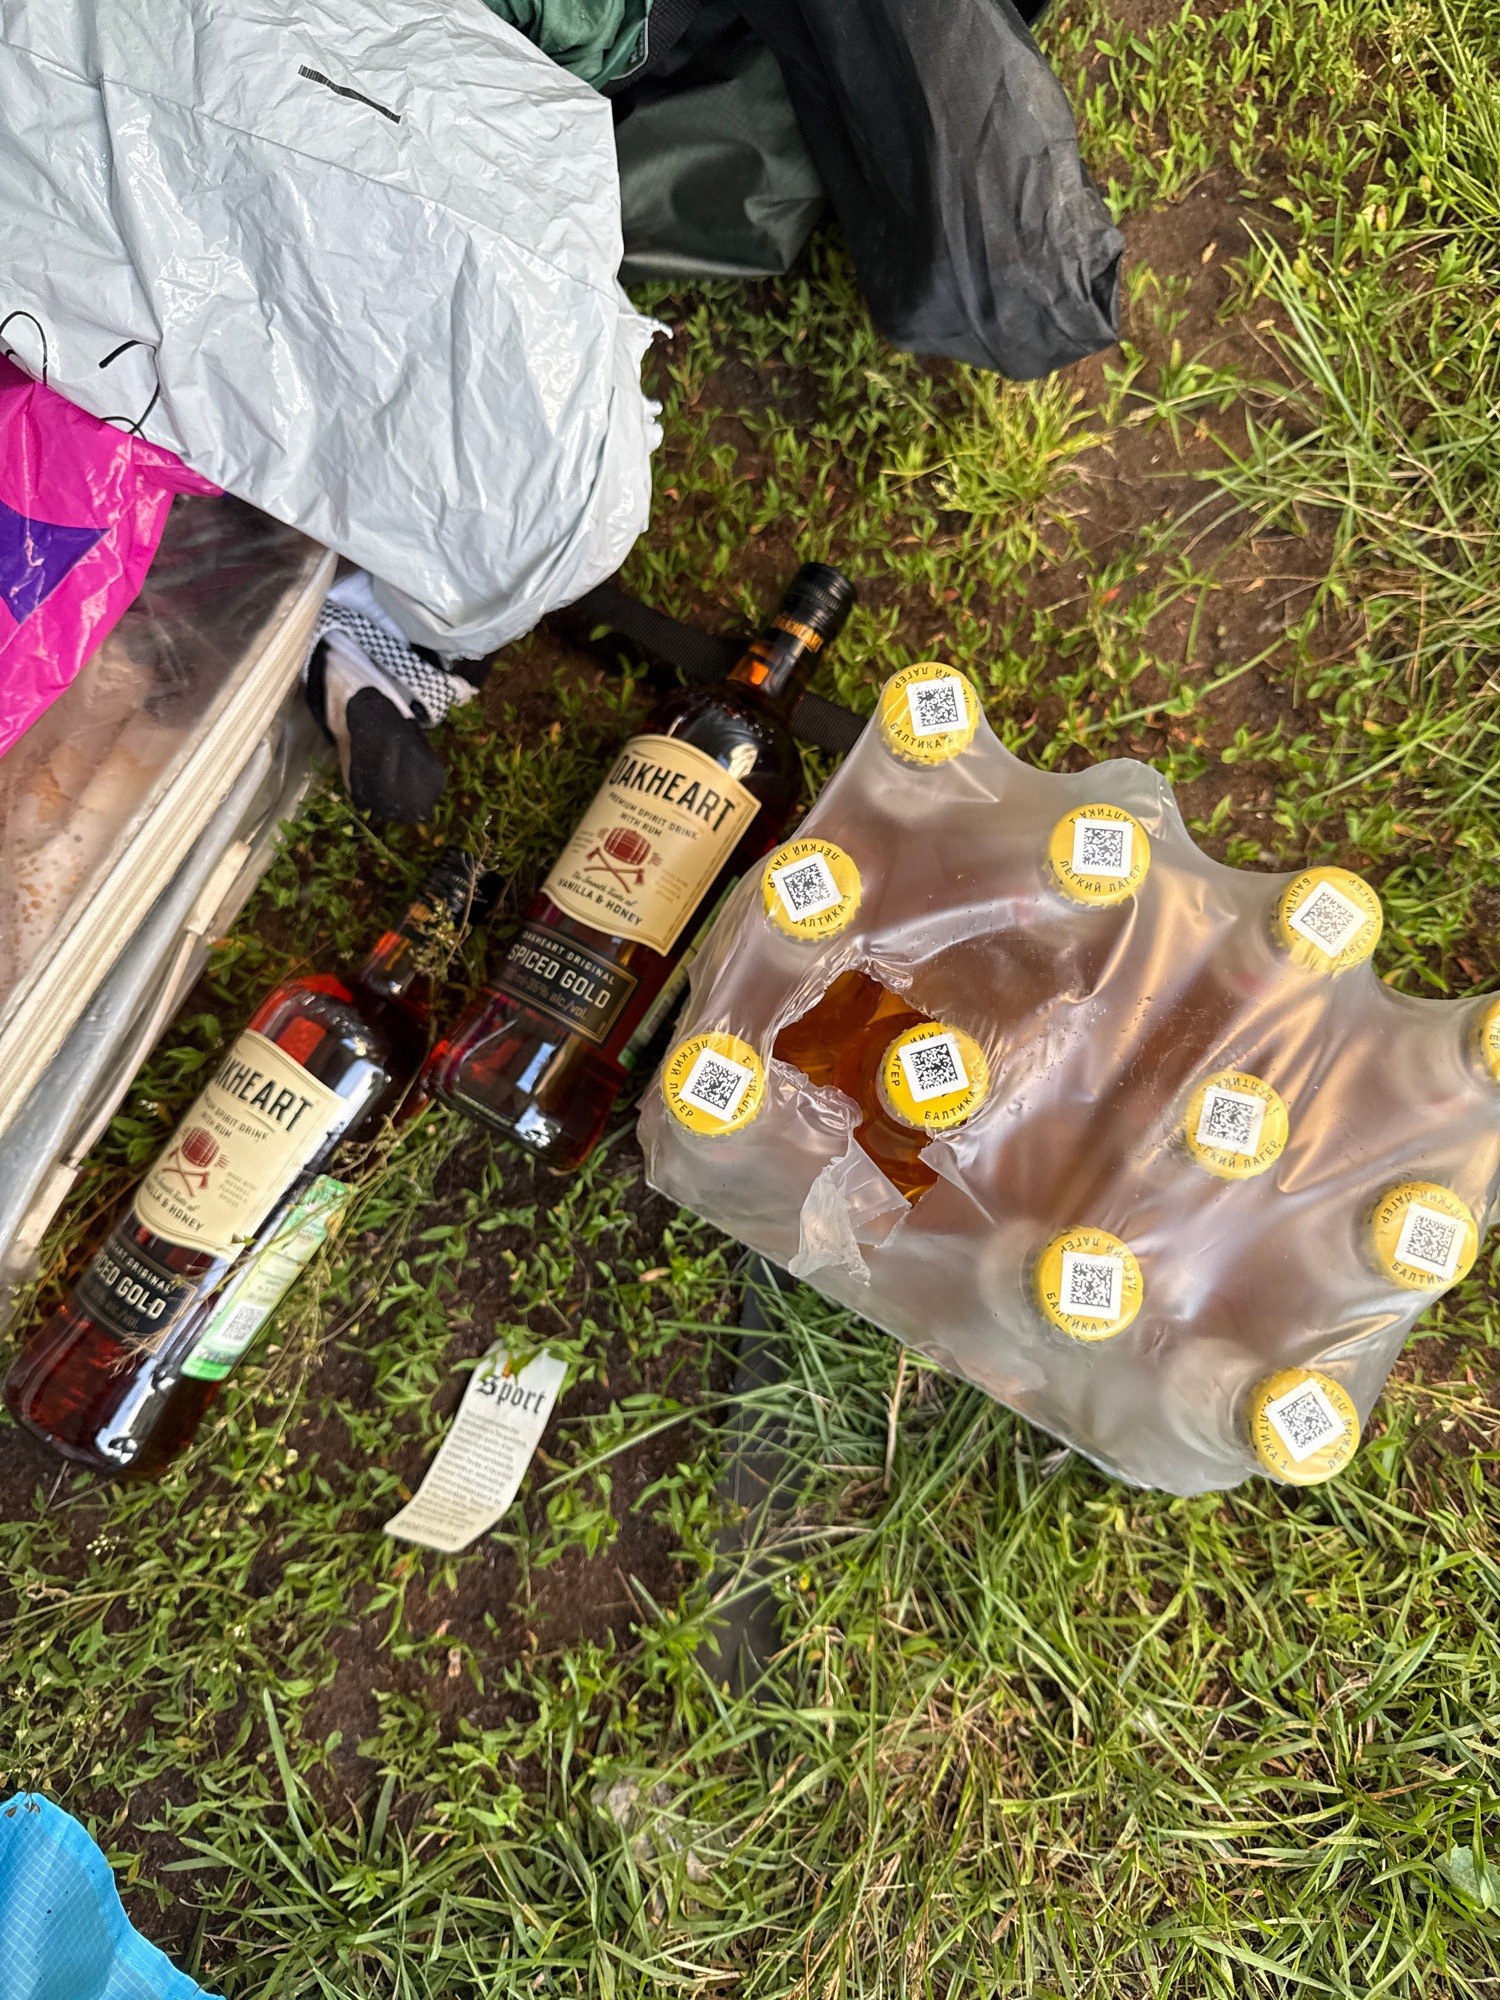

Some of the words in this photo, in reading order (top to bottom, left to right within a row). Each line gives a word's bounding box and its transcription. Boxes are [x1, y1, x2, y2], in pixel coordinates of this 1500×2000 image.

[895, 667, 929, 690] ЛАГЕР
[890, 722, 942, 749] БАЛТИКА
[608, 755, 735, 832] OAKHEART
[608, 792, 637, 812] PREMIUM
[638, 806, 668, 827] SPIRIT
[668, 821, 699, 840] DRINK
[620, 811, 642, 829] WITH
[641, 822, 664, 838] RUM
[1109, 864, 1141, 892] ЛАГЕР
[558, 878, 595, 899] VANILLA
[596, 894, 604, 905] &
[606, 899, 643, 926] HONEY
[843, 894, 852, 902] 1
[1348, 879, 1376, 913] ЛАГЕР
[522, 929, 566, 958] OAKHEART
[566, 952, 616, 985] ORIGINAL
[506, 943, 558, 979] SPICED
[559, 969, 611, 1009] GOLD
[742, 1055, 751, 1064] 1
[890, 1053, 901, 1087] АГЕР
[669, 1082, 694, 1118] ЛАГЕР
[924, 1089, 977, 1121] БАЛТИКА
[215, 1122, 233, 1139] RUM
[239, 1120, 271, 1143] DRINK
[1243, 1139, 1278, 1168] ЛАГЕР
[169, 1203, 204, 1232] HONEY
[1380, 1191, 1412, 1224] ЛАГЕР
[126, 1256, 171, 1294] ORIGINAL
[115, 1275, 167, 1320] GOLD
[1102, 1320, 1111, 1330] 1
[475, 1374, 547, 1415] Sport
[1260, 1395, 1278, 1460] БЛТИКА
[1279, 1460, 1288, 1470] 1
